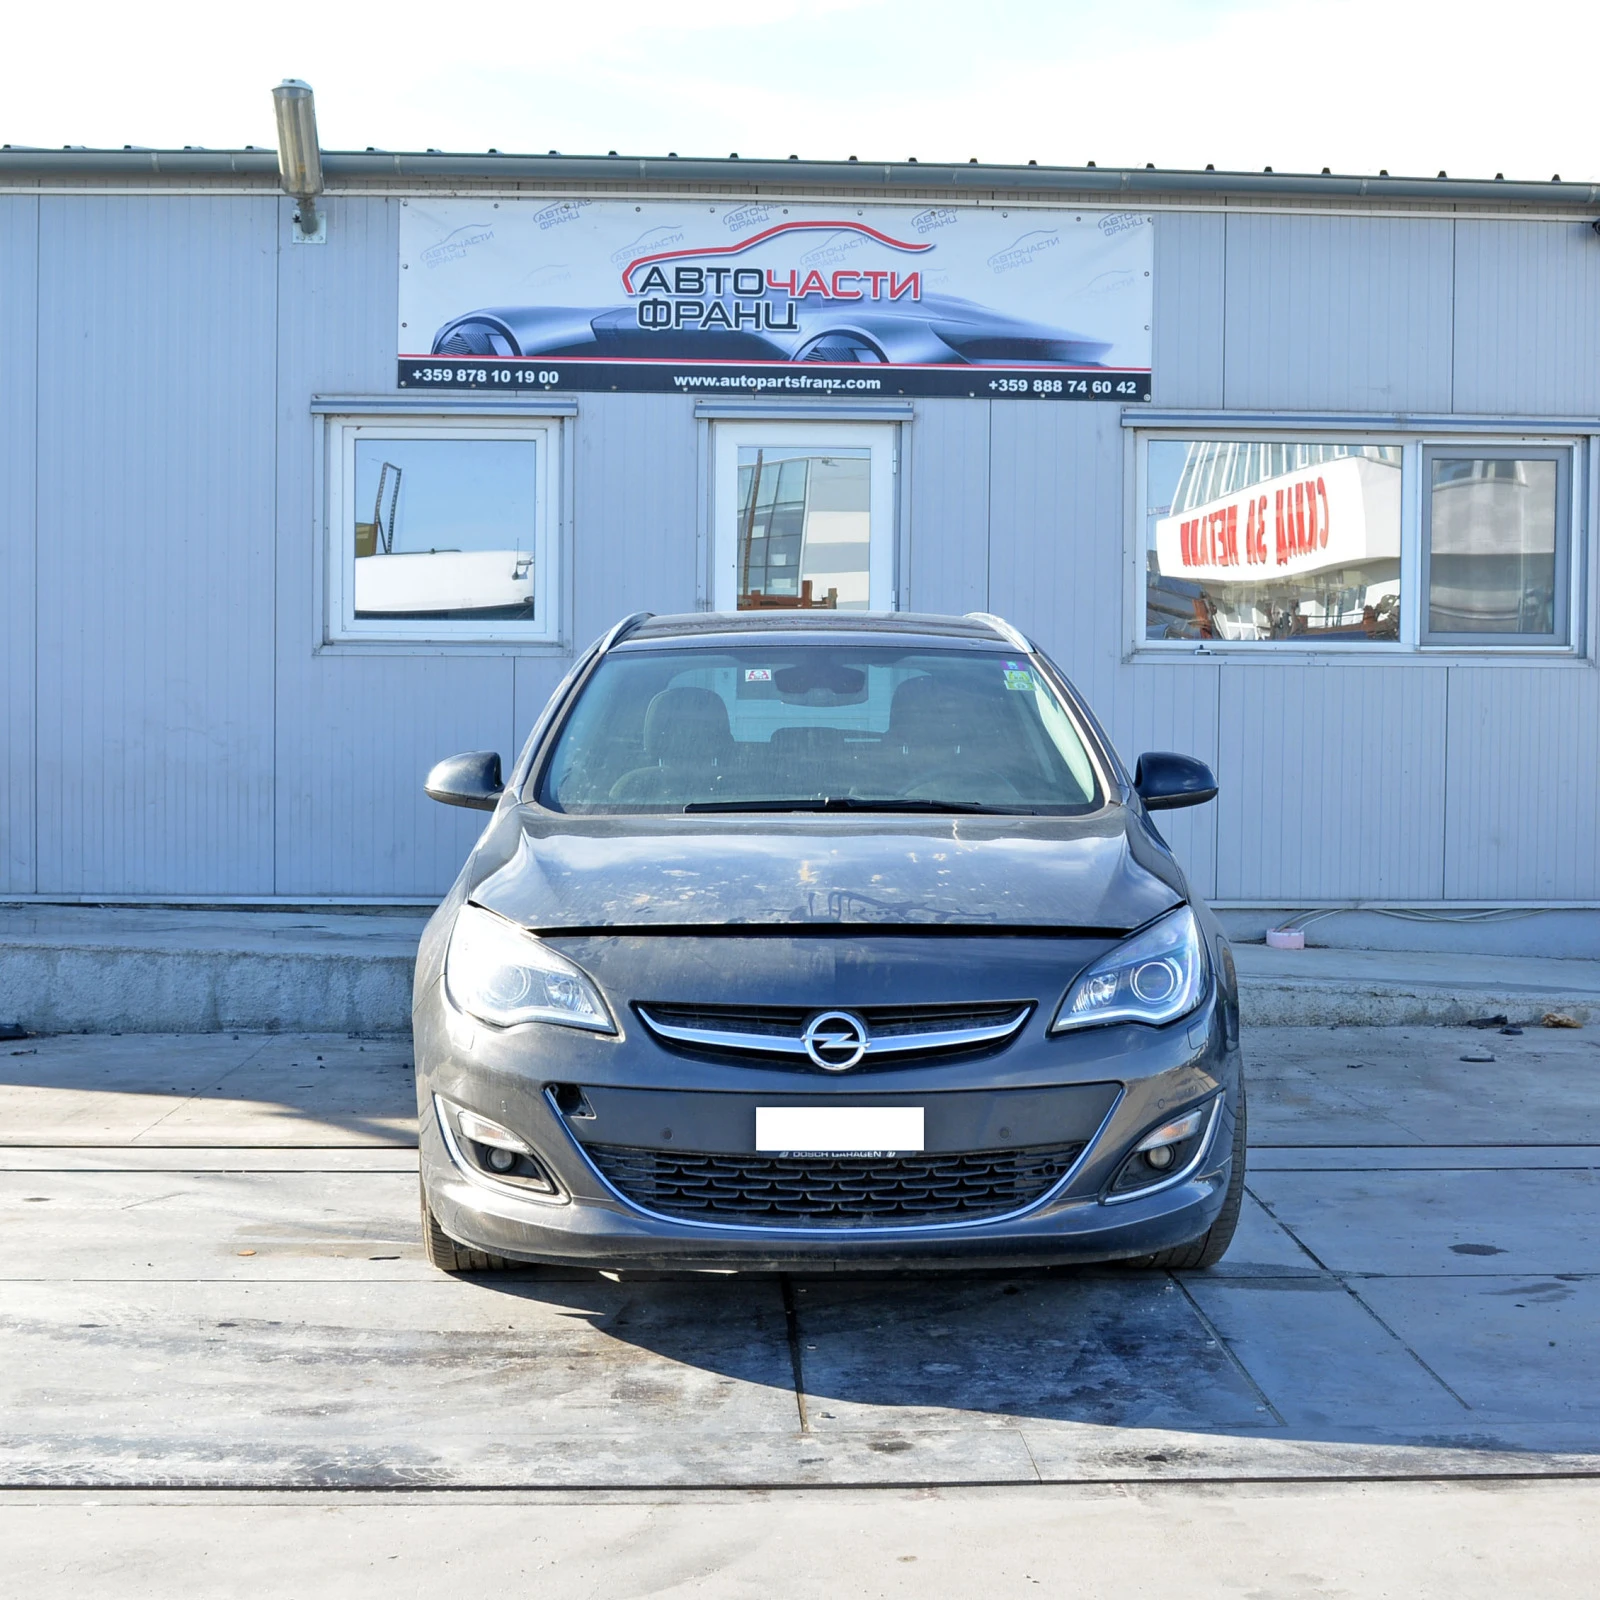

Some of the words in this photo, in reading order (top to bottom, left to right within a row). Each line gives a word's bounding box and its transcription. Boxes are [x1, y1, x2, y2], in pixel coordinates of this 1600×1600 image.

[540, 210, 580, 230] ФРАНЦ
[730, 212, 770, 232] ФРАНЦ
[917, 215, 958, 233] ФРАНЦ
[1104, 218, 1144, 236] ФРАНЦ
[425, 230, 495, 261] АВТОЧАСТИ
[991, 236, 1060, 265] АВТОЧАСТИ
[637, 265, 921, 300] АВТОЧАСТИ
[637, 297, 798, 330] ФРАНЦ
[412, 368, 453, 382] +359
[456, 369, 487, 383] 878
[491, 370, 511, 383] 10
[515, 370, 535, 383] 19
[538, 370, 559, 384] 00
[673, 375, 881, 390] www.autopartsfranz.com
[988, 379, 1028, 392] +359
[1033, 380, 1063, 393] 888
[1067, 380, 1088, 393] 74
[1092, 381, 1112, 394] 60
[1116, 381, 1137, 394] 42
